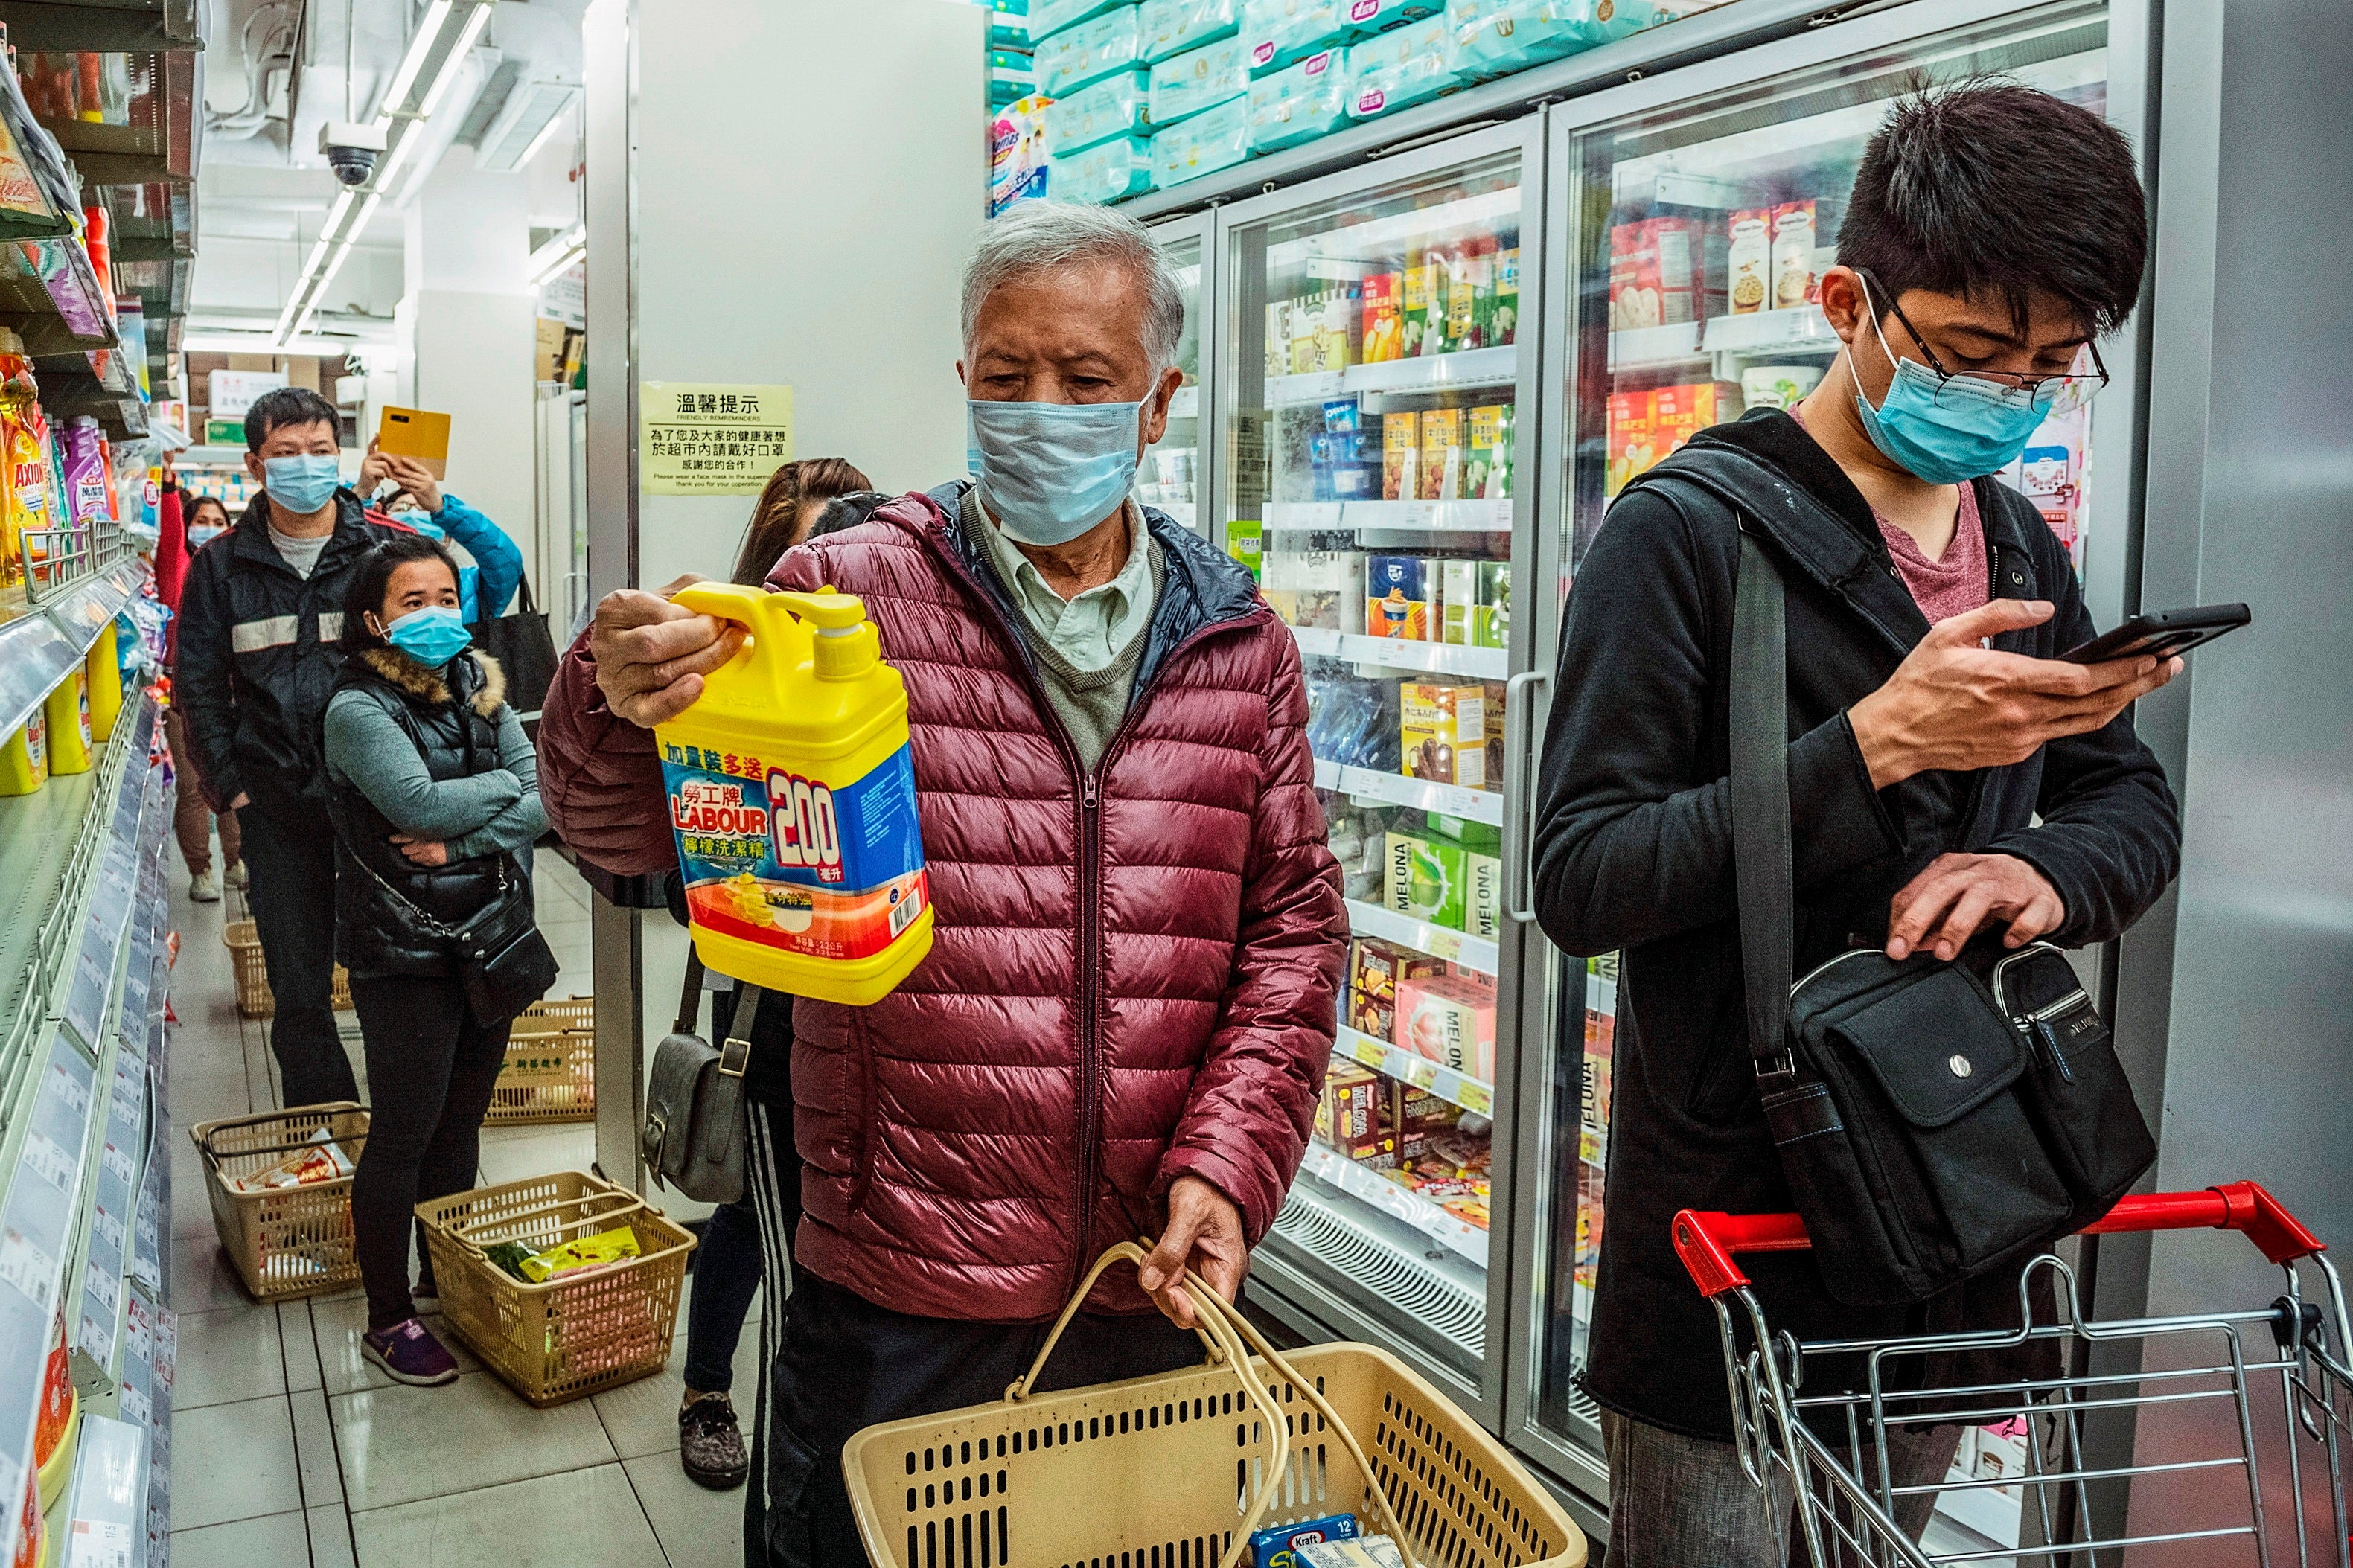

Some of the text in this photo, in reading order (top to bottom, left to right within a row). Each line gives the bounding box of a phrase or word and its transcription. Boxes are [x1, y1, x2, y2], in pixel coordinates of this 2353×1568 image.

[677, 394, 759, 414] 溫馨提示
[651, 429, 785, 442] 為了您及大家的健康著想
[652, 442, 784, 457] 於超市內請戴好口罩
[665, 741, 763, 780] 加量裝多送
[684, 785, 741, 807] 勞工牌
[671, 795, 767, 834] LABOUR
[769, 772, 841, 865] 200
[683, 835, 764, 859] 檸檬洗潔精
[1394, 843, 1409, 910] MELONA
[1477, 864, 1492, 935] MELONA
[1352, 1086, 1367, 1139] MELONA
[1338, 1520, 1352, 1533] 12
[1295, 1534, 1318, 1547] Kraft
